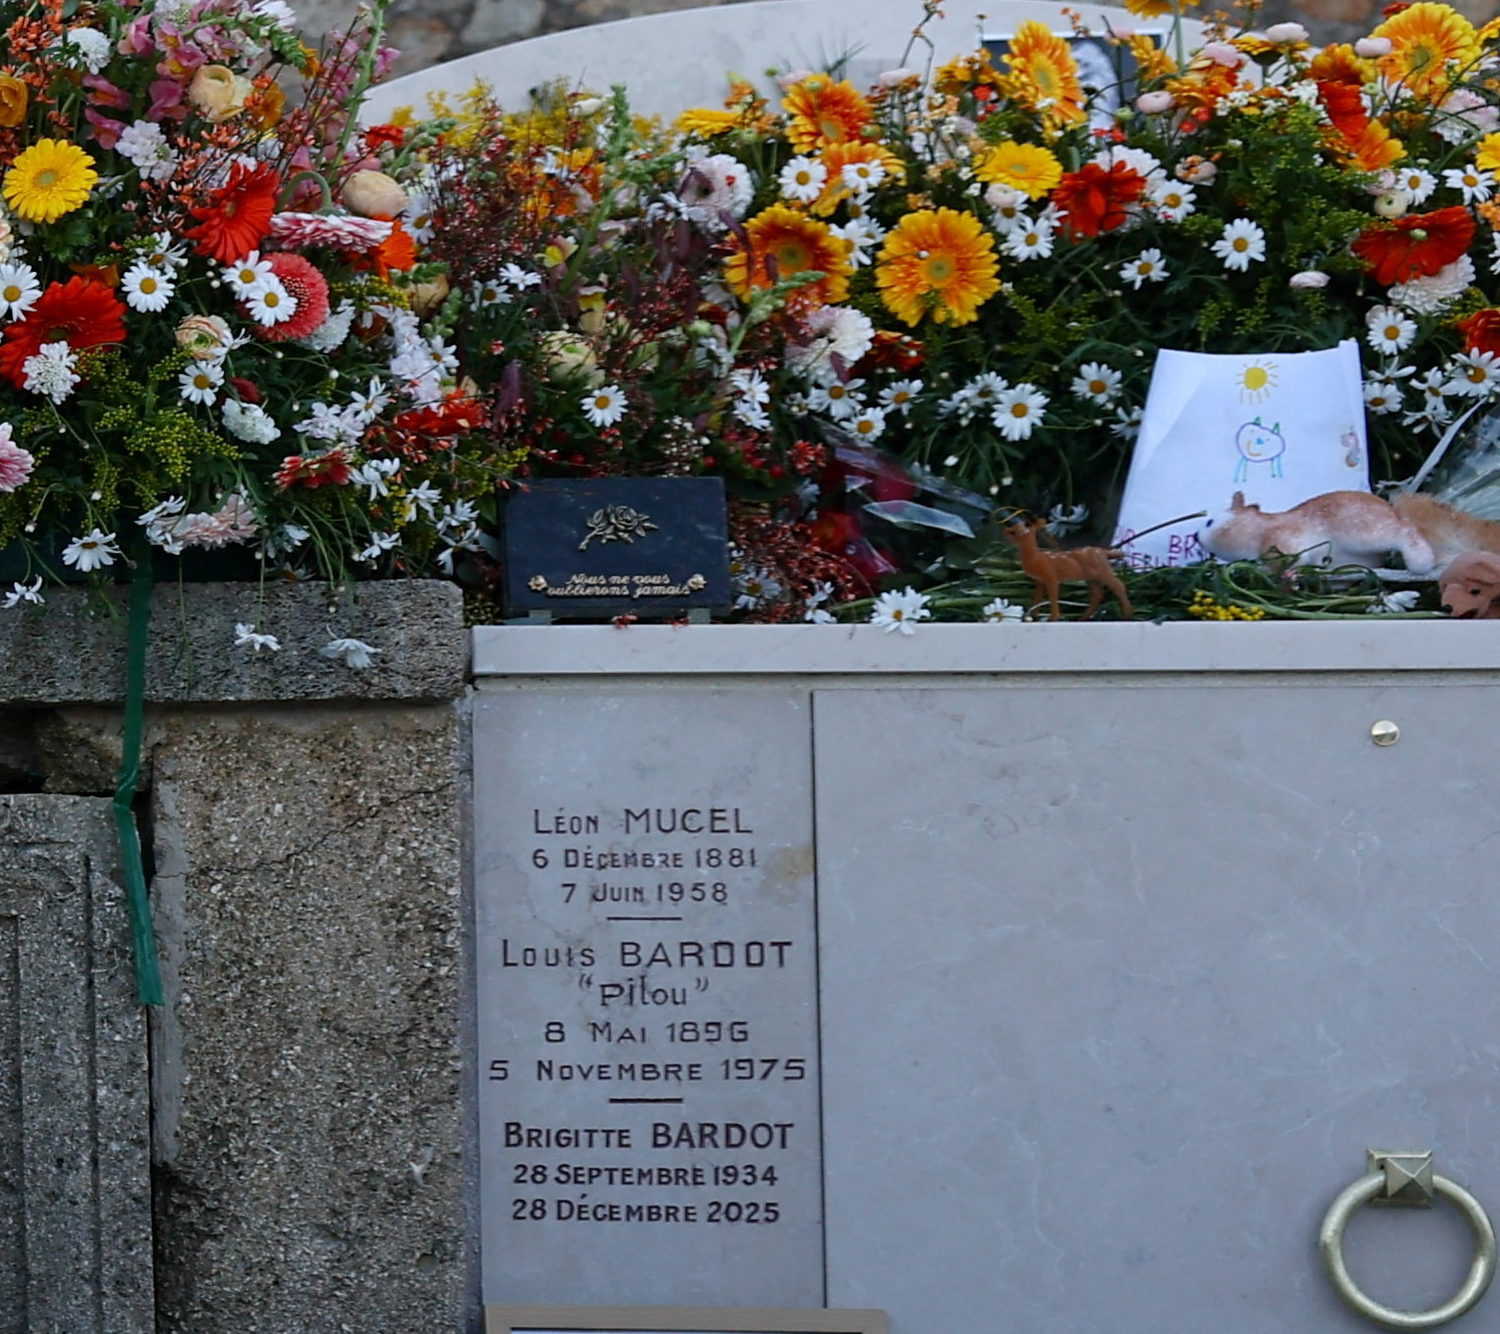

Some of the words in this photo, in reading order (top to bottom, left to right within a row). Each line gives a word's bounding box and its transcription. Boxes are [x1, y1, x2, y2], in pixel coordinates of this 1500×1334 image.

[565, 573, 607, 585] Nous
[608, 576, 630, 585] ne
[631, 573, 671, 585] vous
[547, 583, 630, 597] oublierons
[634, 584, 691, 599] jamais
[625, 808, 753, 835] MUCEL
[532, 849, 548, 869] 6
[695, 848, 758, 869] 1881
[561, 883, 576, 904] 7
[658, 883, 728, 904] 1958
[620, 941, 792, 969] BARDOT
[544, 1022, 566, 1044] 8
[667, 1022, 749, 1043] 1896
[489, 1060, 509, 1081] 5
[721, 1058, 805, 1081] 1975
[504, 1122, 632, 1149] BRIGITTE
[652, 1122, 794, 1149] BARDOT
[513, 1164, 547, 1186] 28
[554, 1163, 705, 1186] SEPTEMBRE
[713, 1164, 778, 1186] 1934
[512, 1200, 547, 1222] 28
[708, 1201, 780, 1223] 2025
